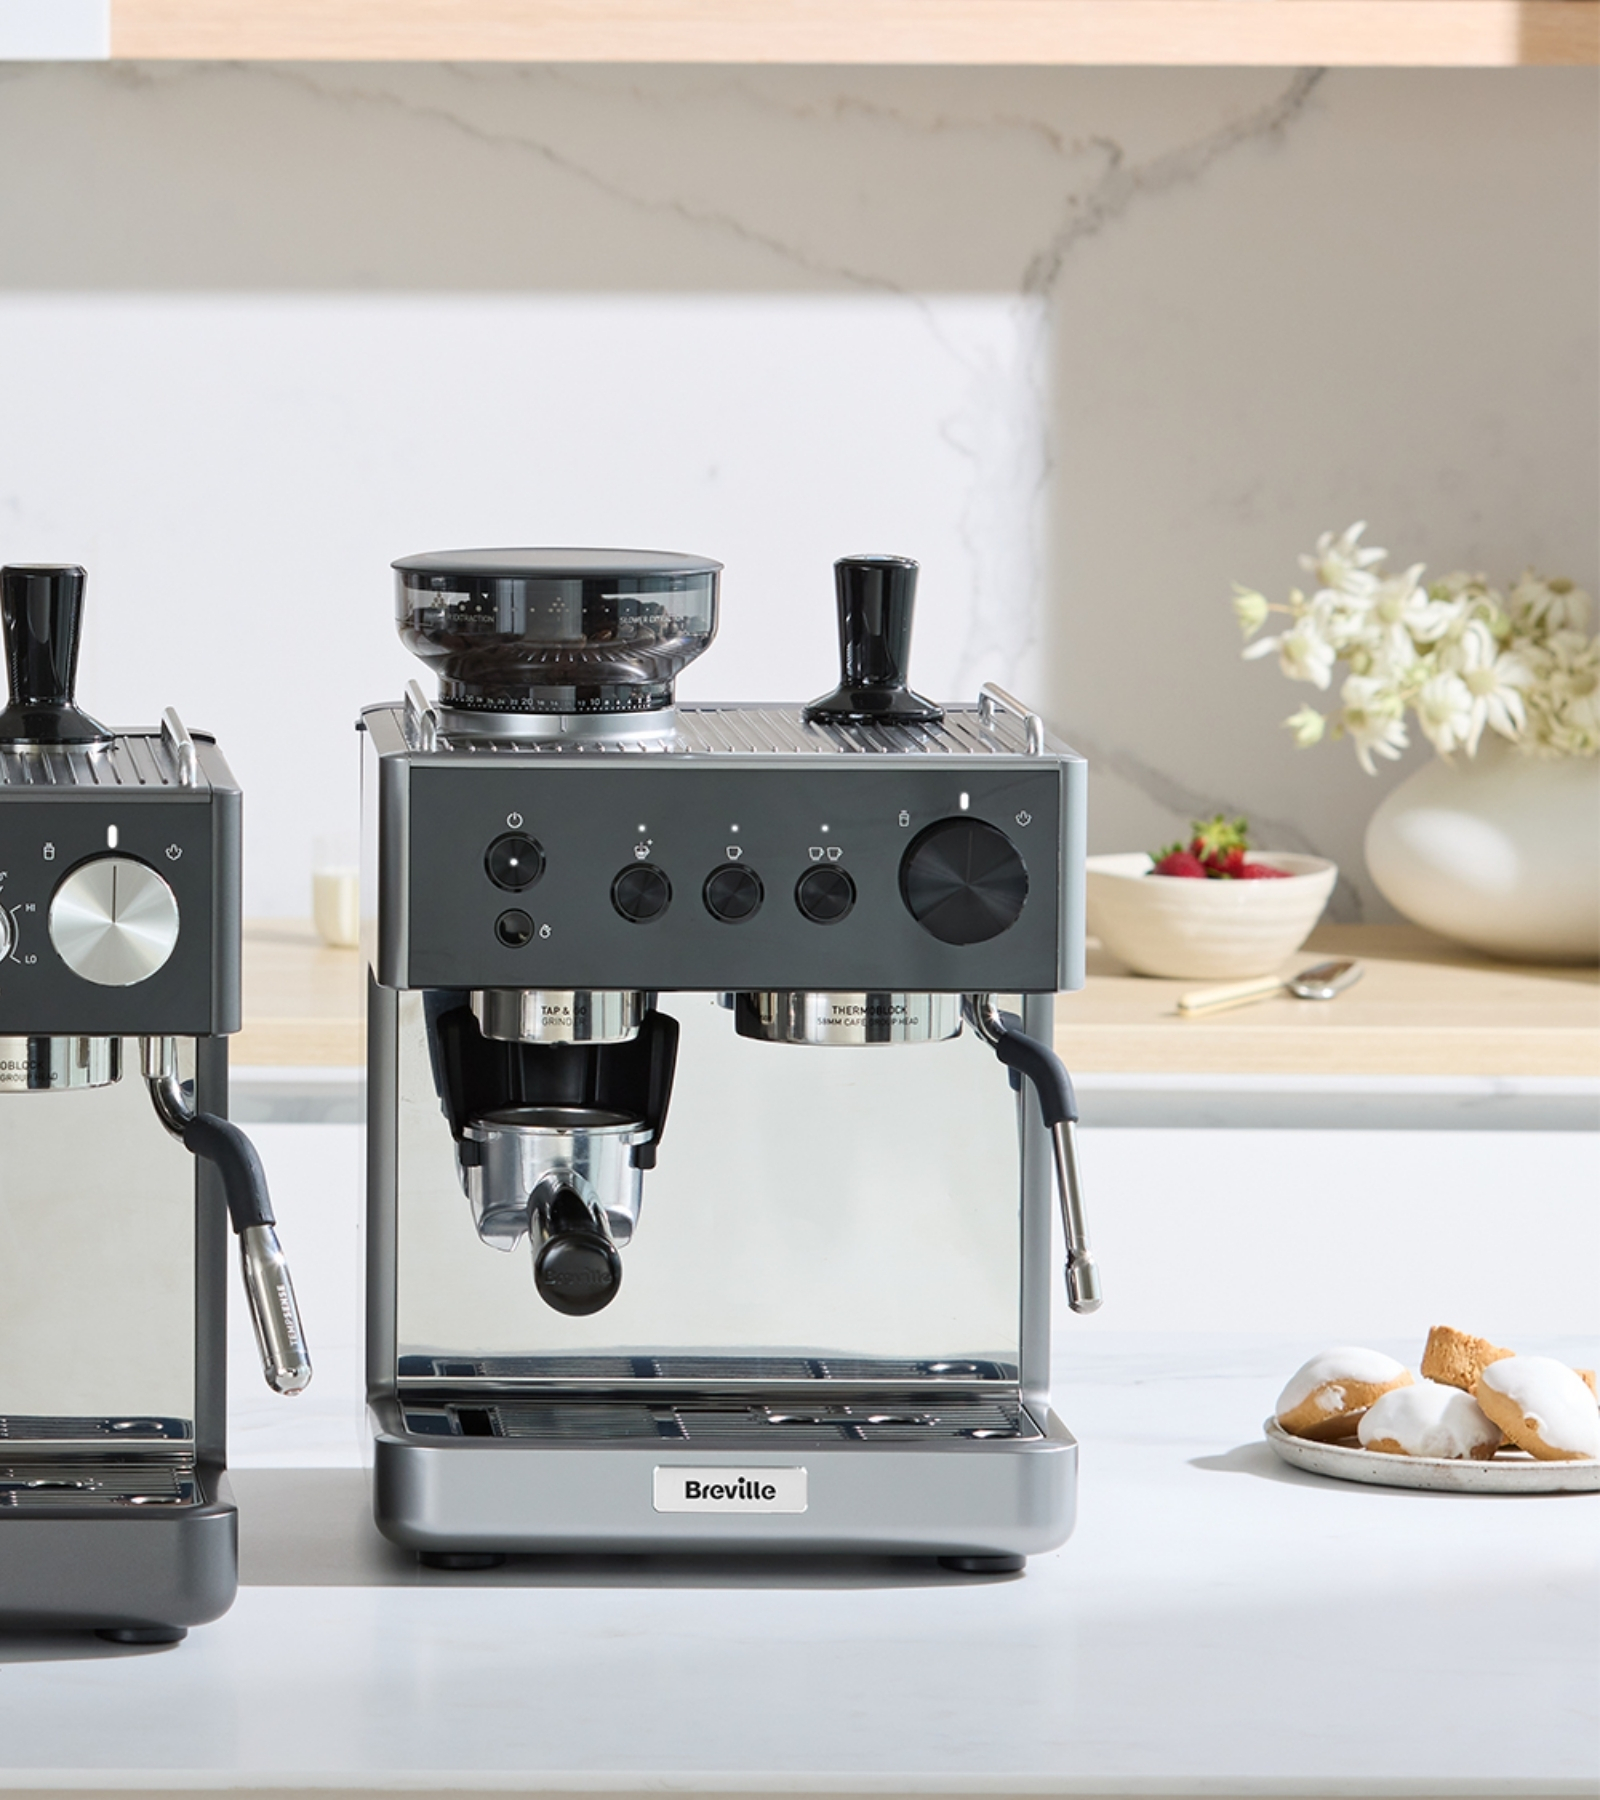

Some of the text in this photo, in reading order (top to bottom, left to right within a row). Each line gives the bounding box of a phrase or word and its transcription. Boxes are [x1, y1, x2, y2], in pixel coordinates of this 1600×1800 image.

[25, 903, 36, 912] HI
[25, 955, 37, 964] LO
[541, 1006, 560, 1015] TAP
[562, 1006, 570, 1015] &
[832, 1005, 907, 1015] THERMOBLOCK
[542, 1017, 587, 1026] GRINDR
[544, 1266, 612, 1285] Breville
[276, 1284, 298, 1346] TEMPSENSE
[685, 1476, 776, 1500] Breville
